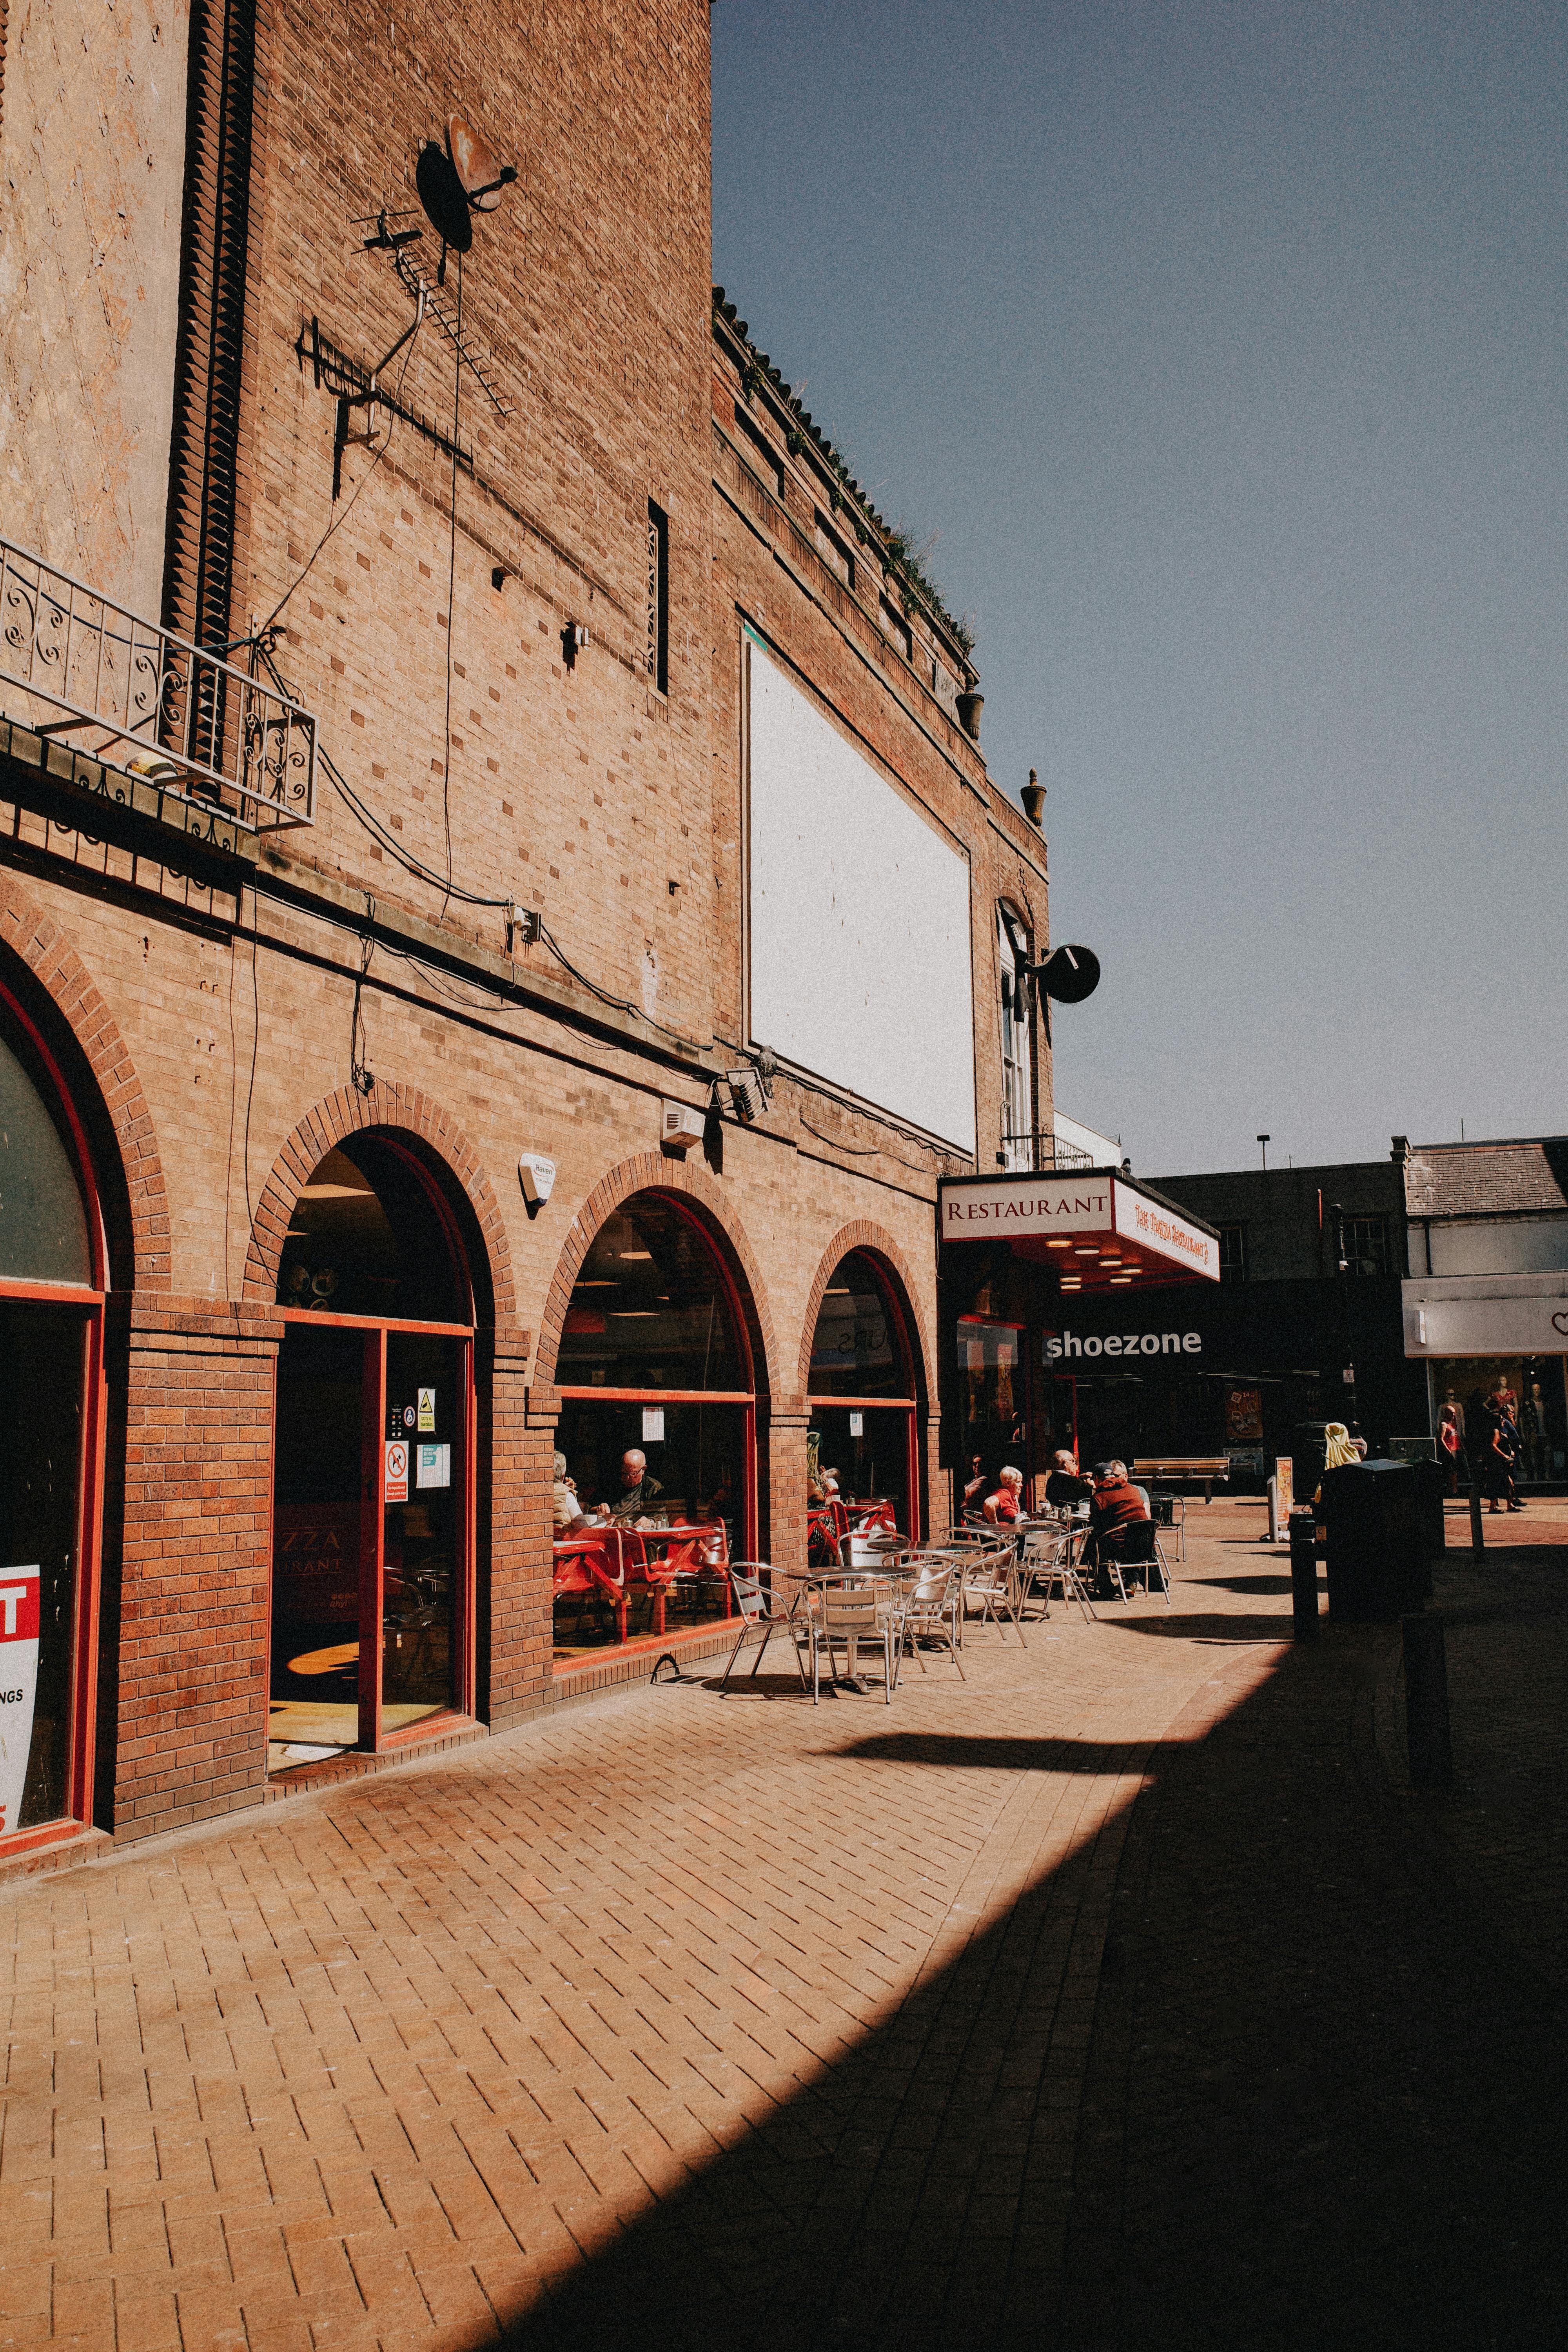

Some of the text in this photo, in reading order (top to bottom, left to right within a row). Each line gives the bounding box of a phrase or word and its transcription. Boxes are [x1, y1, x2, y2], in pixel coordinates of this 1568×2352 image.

[536, 1164, 552, 1175] Raven
[947, 1196, 1108, 1221] RESTAURANT
[1135, 1204, 1149, 1230] THE
[1047, 1331, 1201, 1358] shoezone
